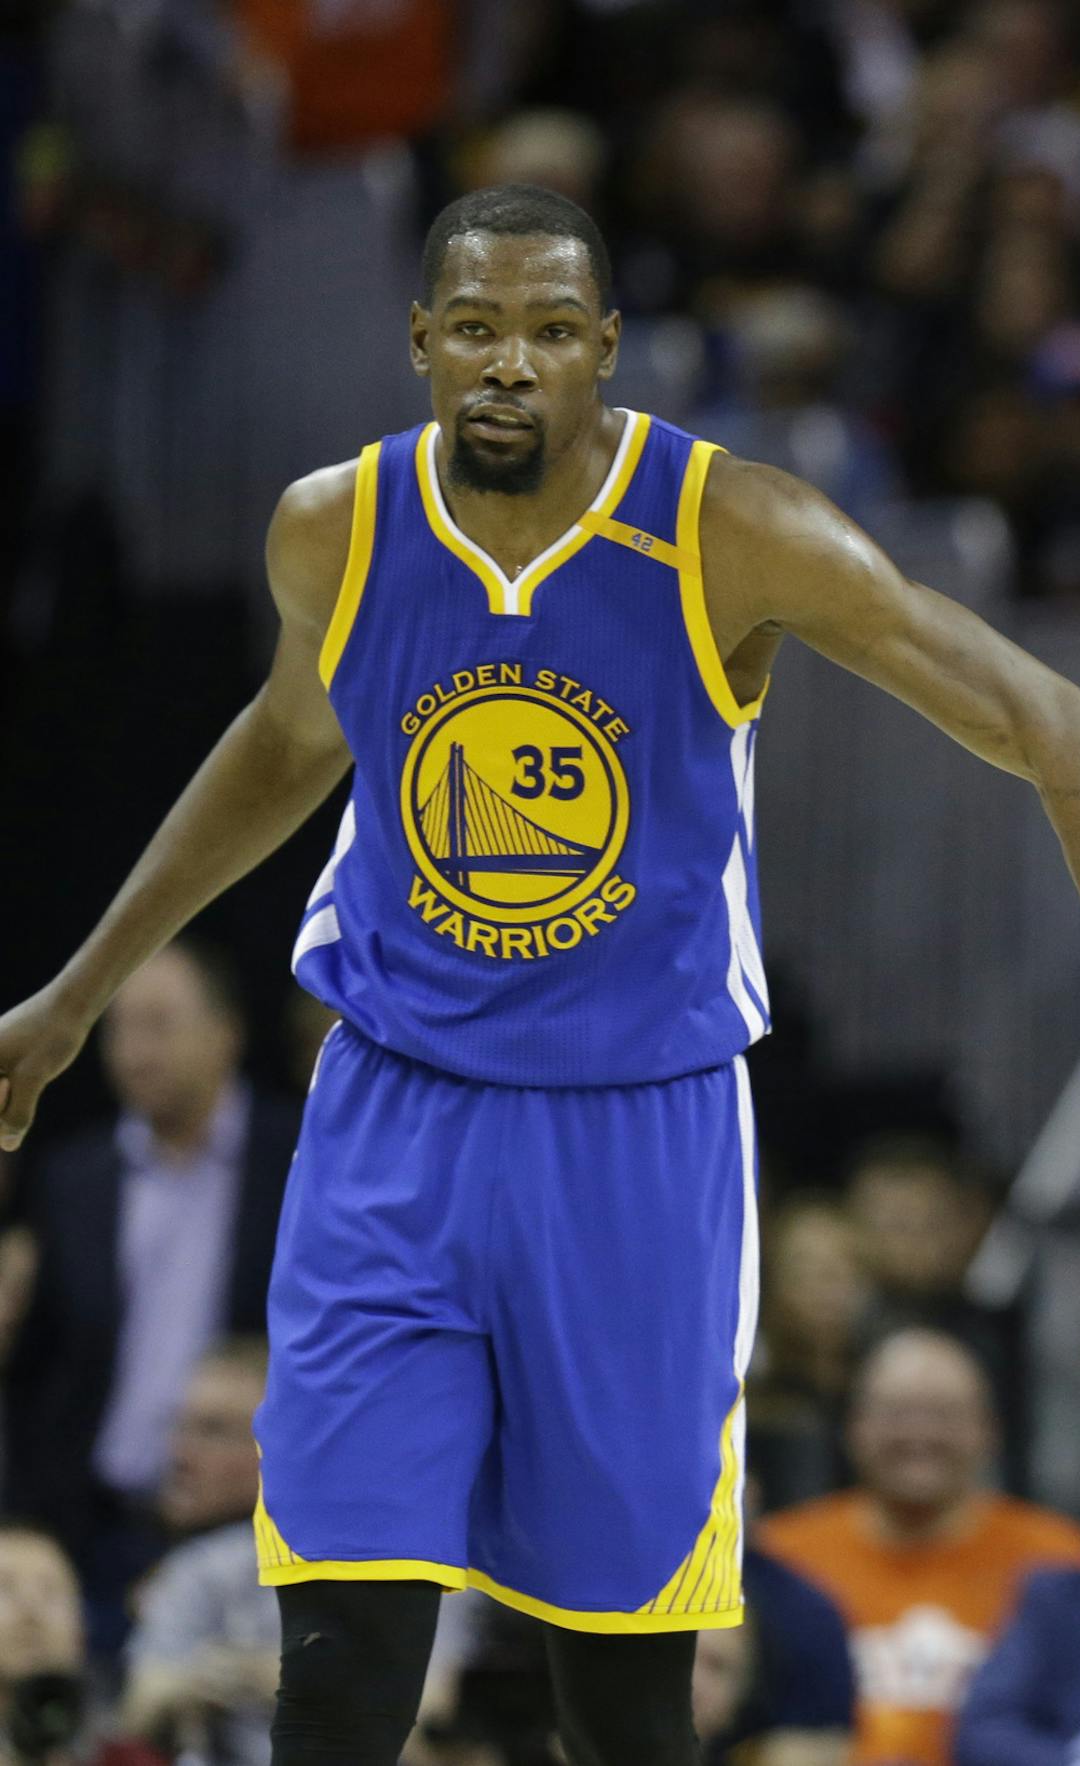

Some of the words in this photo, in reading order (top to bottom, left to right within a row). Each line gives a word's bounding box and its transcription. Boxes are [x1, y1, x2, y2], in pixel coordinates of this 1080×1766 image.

[631, 533, 653, 551] 42
[400, 663, 523, 735] GOLDEN
[534, 669, 630, 743] STATE
[511, 744, 586, 801] 35
[407, 874, 638, 960] WARRIORS
